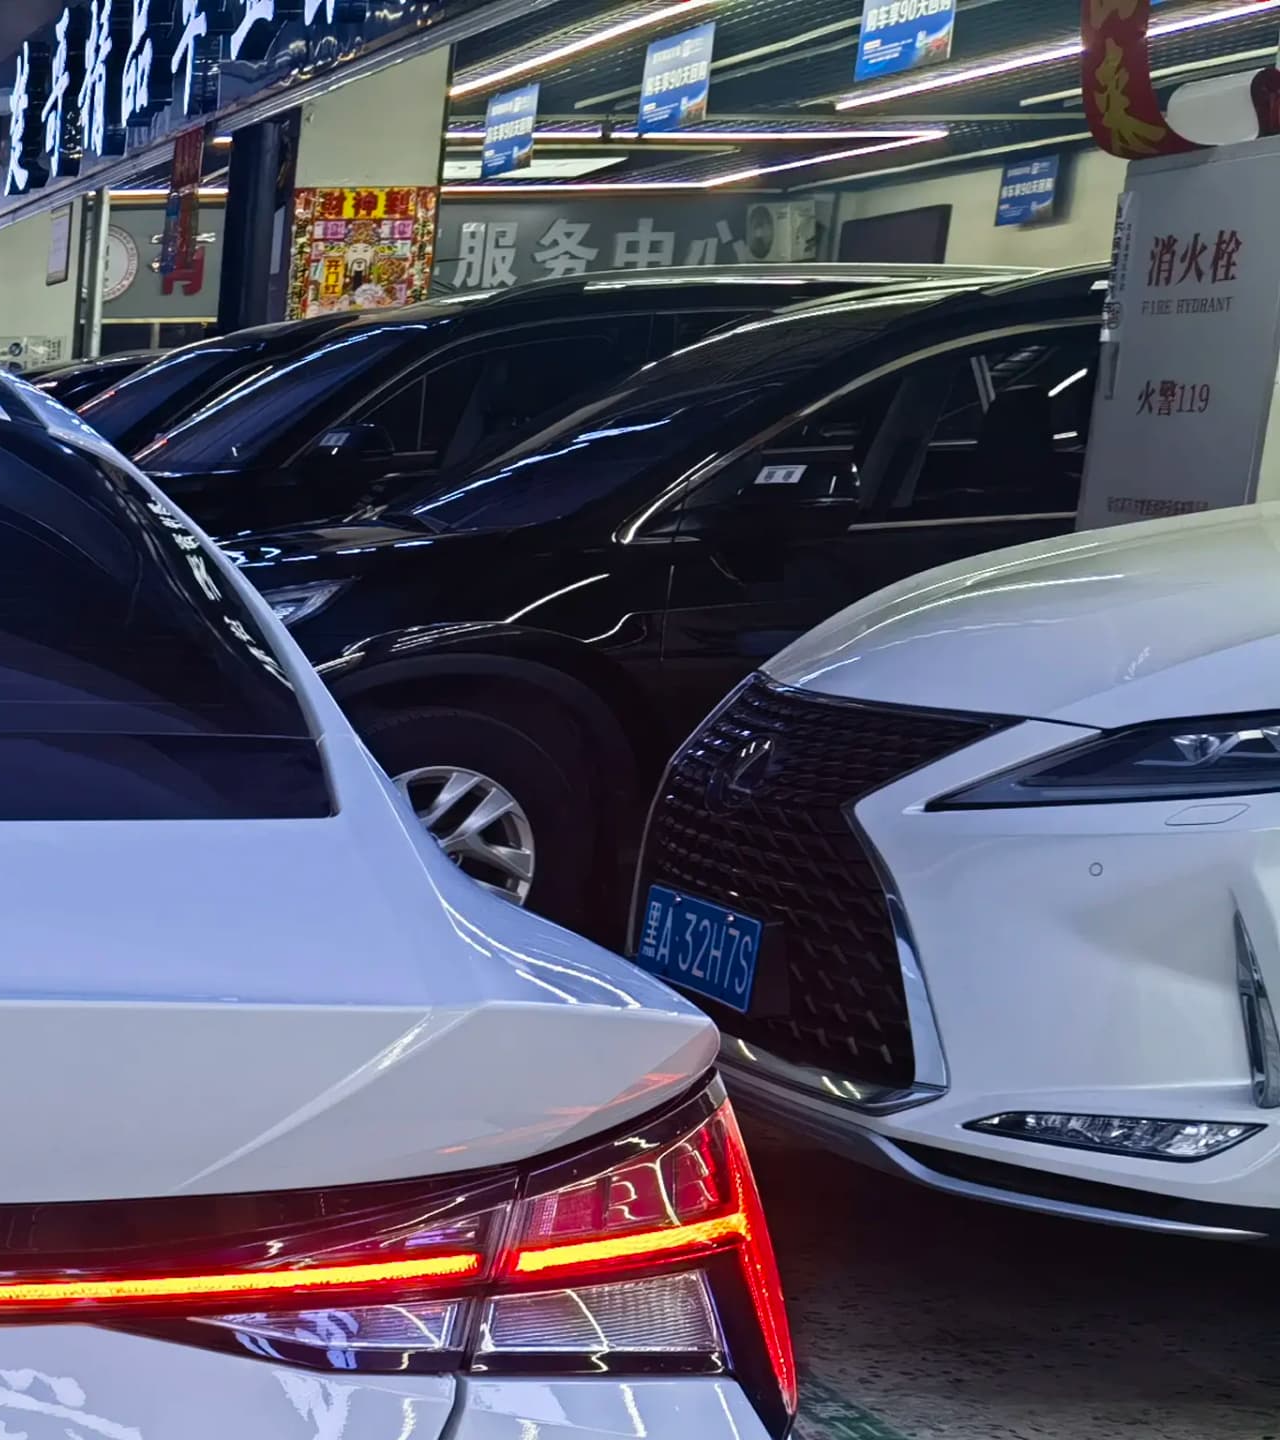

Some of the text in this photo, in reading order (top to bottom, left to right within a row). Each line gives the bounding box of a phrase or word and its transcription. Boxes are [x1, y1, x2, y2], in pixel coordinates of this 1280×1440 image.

[1146, 230, 1242, 287] 消火栓
[1142, 296, 1233, 315] FIRE HYDRANT
[1135, 379, 1211, 417] 火警119
